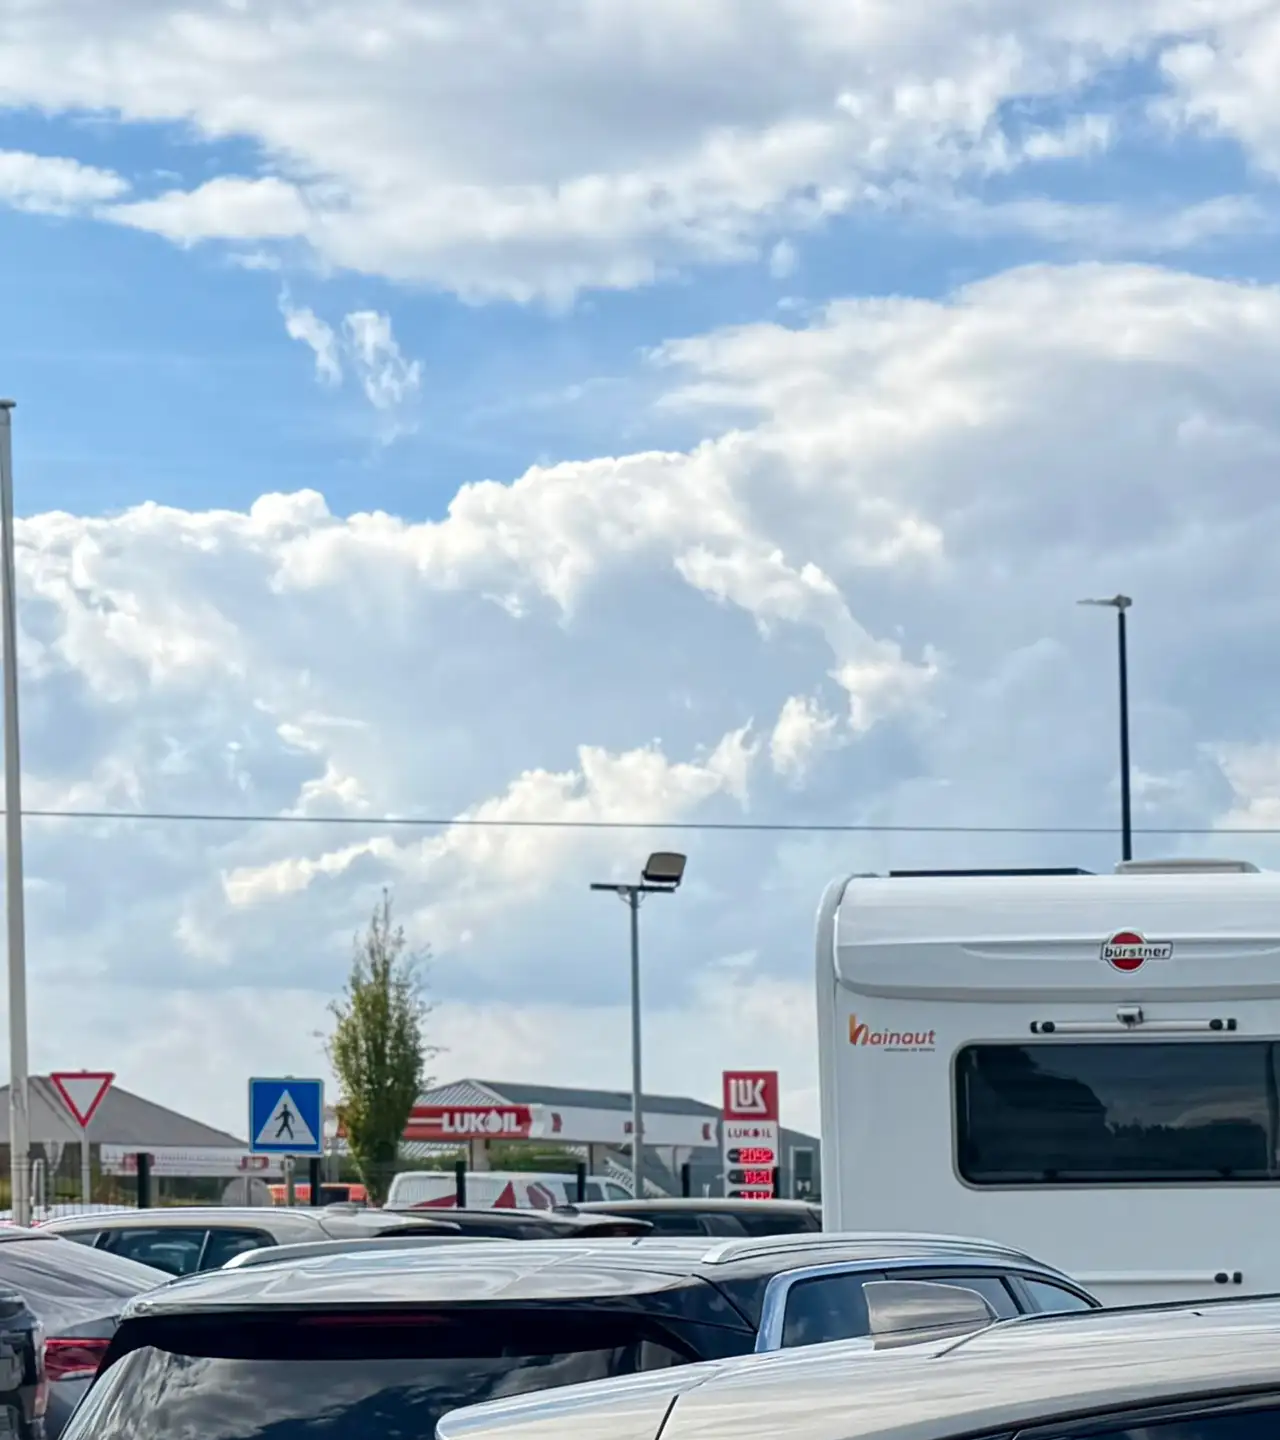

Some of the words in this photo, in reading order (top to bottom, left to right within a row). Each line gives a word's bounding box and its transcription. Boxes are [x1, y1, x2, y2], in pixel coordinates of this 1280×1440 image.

[1104, 946, 1169, 958] bürstner
[849, 1013, 936, 1046] hainaut
[728, 1078, 768, 1113] LUK
[442, 1108, 522, 1133] LUKOIL
[728, 1127, 773, 1139] LUKOIL
